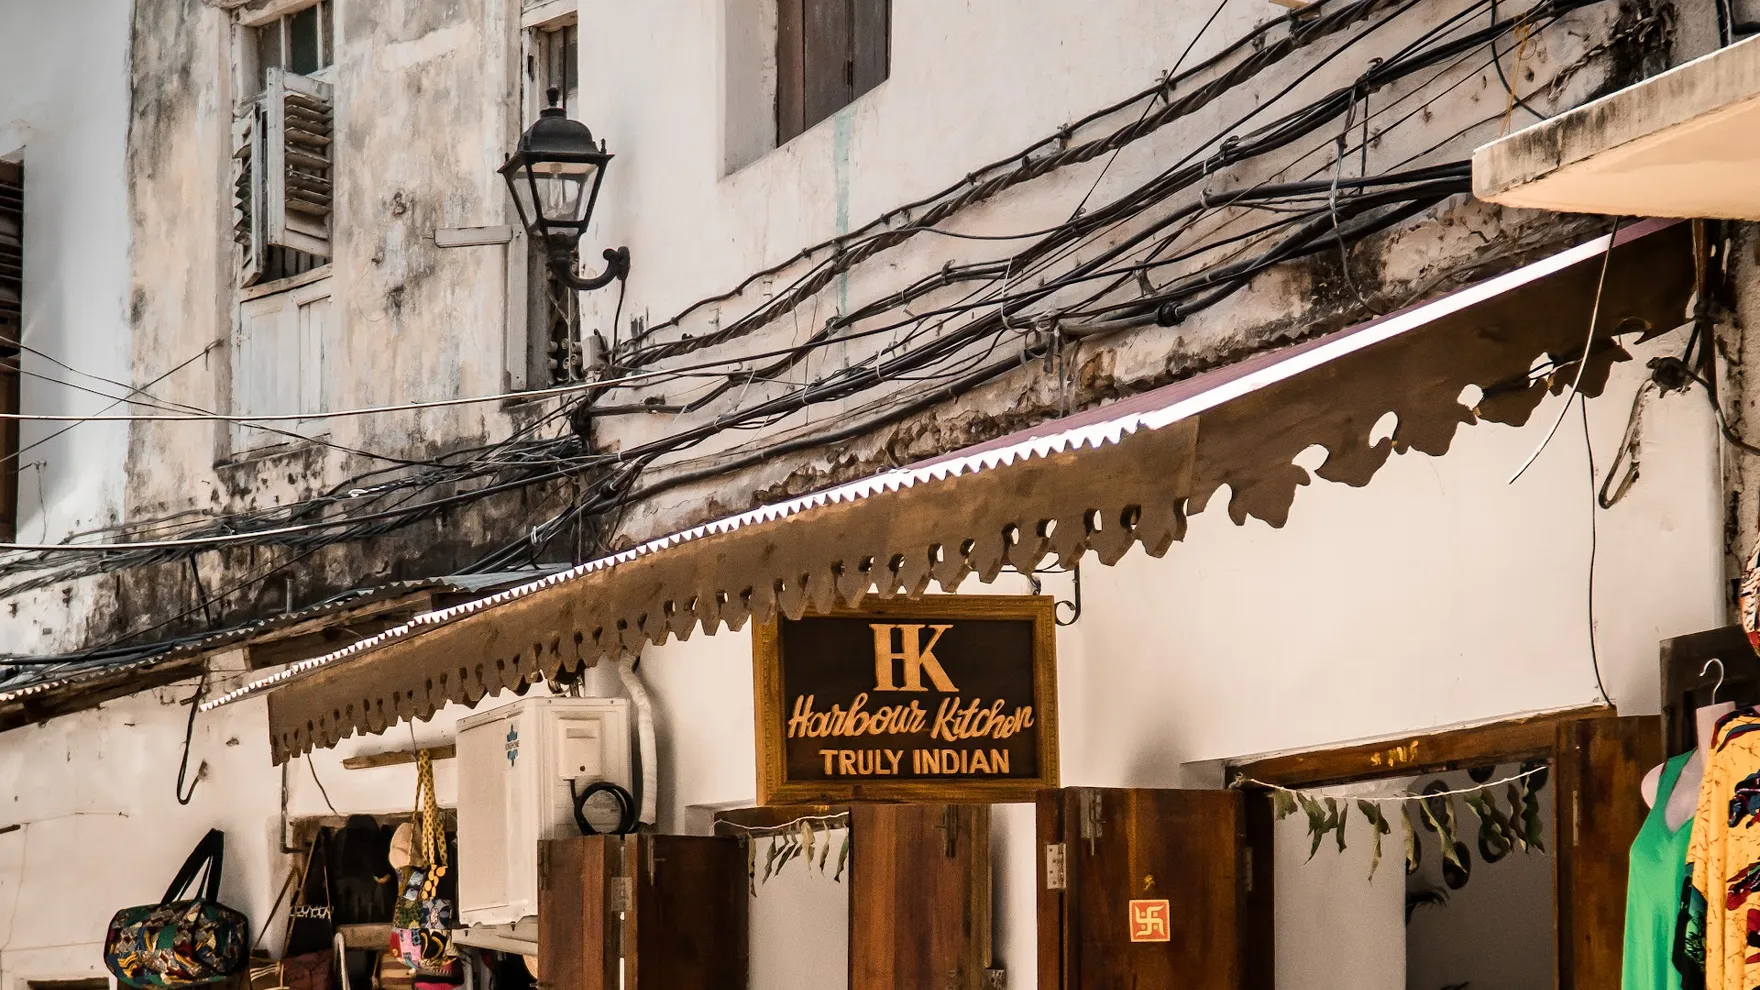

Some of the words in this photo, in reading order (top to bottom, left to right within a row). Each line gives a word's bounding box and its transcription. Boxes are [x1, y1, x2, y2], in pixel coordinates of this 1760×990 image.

[868, 623, 960, 692] HK
[787, 692, 928, 739] Harbour
[930, 696, 1035, 742] Kitchen
[819, 749, 904, 776] TRULY
[913, 748, 1010, 775] INDIAN
